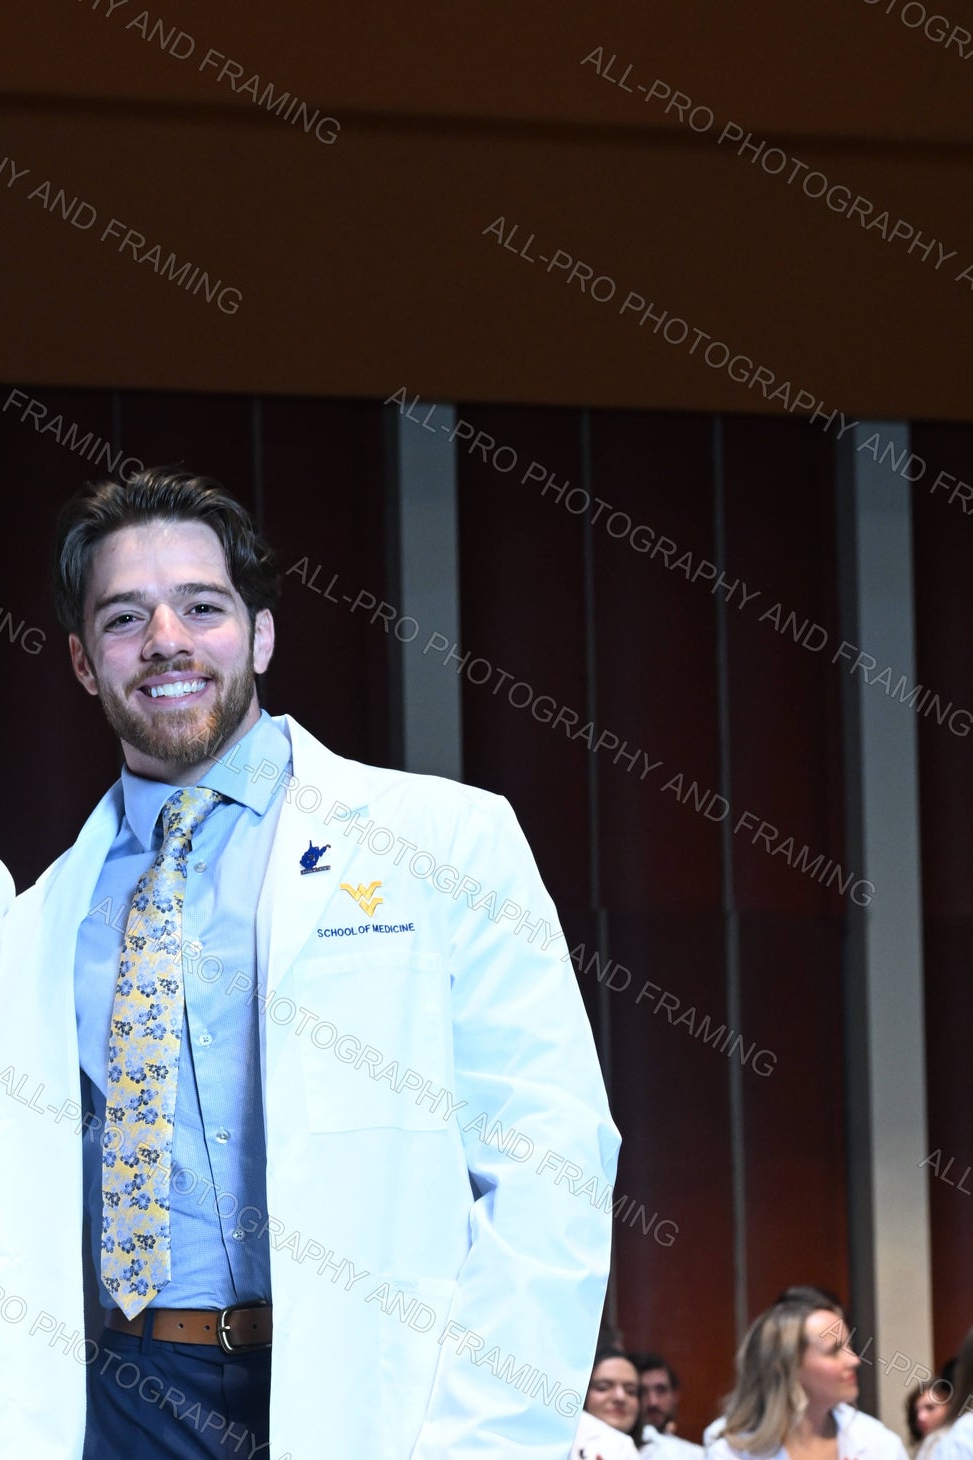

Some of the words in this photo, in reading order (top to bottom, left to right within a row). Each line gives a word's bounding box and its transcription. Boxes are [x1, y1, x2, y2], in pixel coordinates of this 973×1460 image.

[317, 927, 358, 938] SCHOOL
[358, 924, 370, 934] OF
[372, 923, 416, 934] MEDICINE
